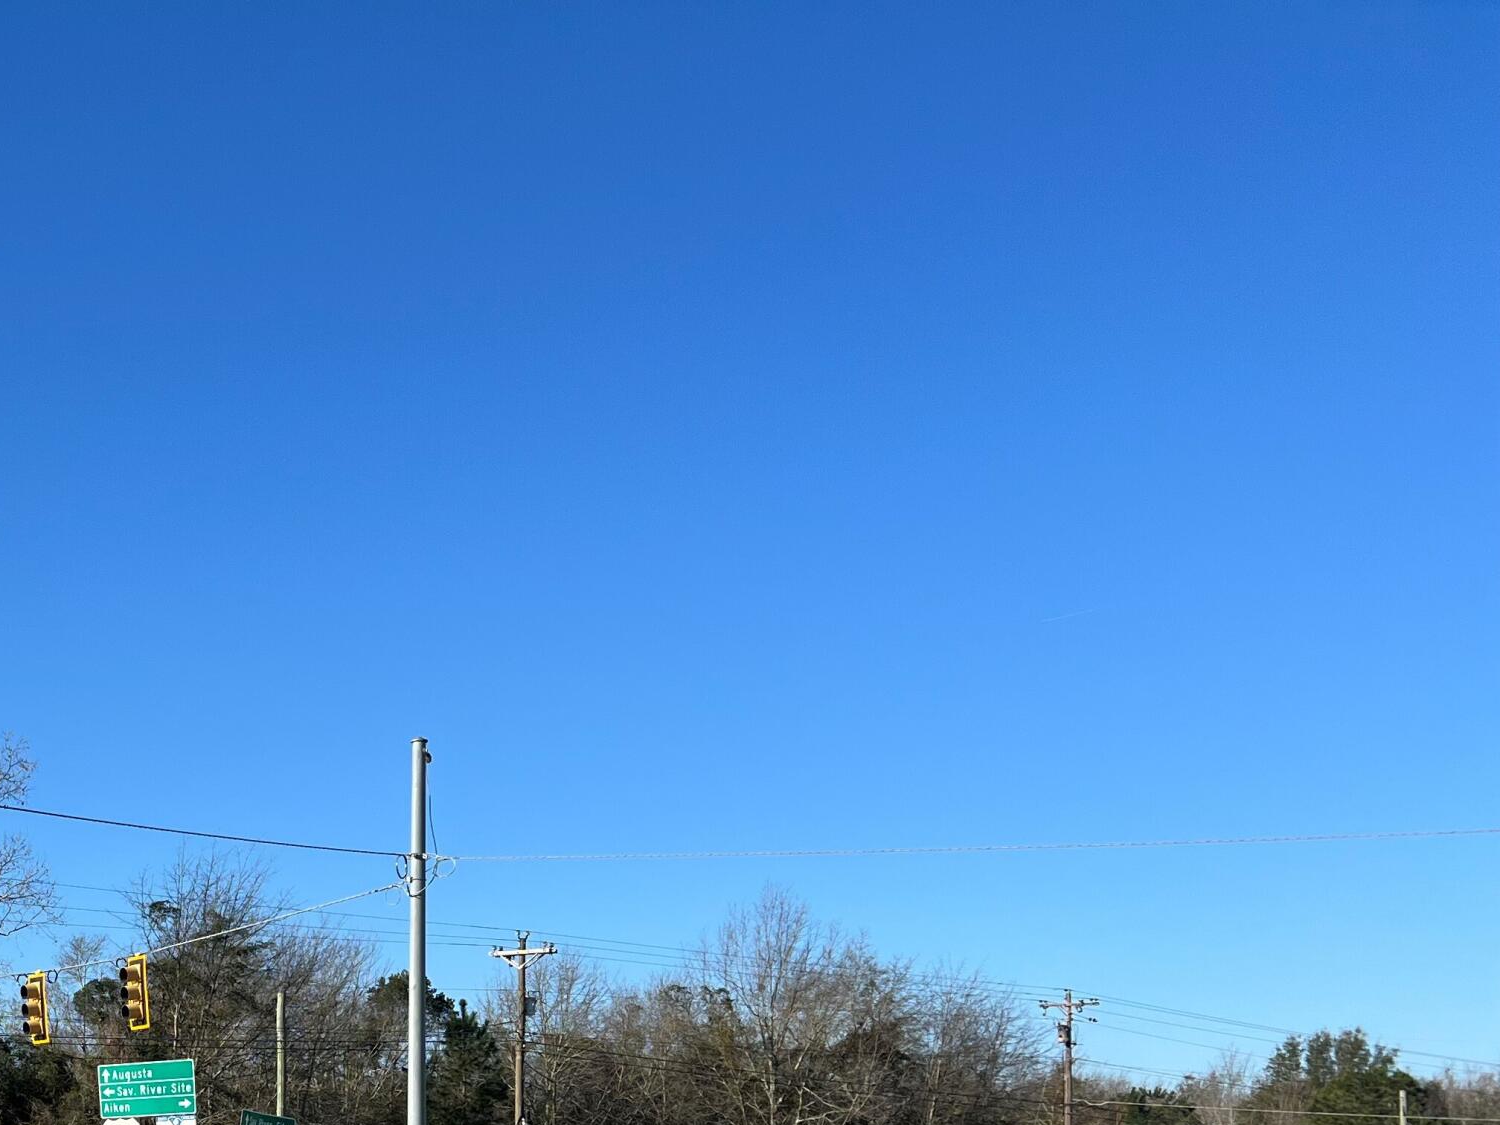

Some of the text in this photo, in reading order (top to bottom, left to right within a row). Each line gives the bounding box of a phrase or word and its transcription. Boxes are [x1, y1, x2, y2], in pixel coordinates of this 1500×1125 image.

[112, 1068, 153, 1083] Augusta
[116, 1082, 192, 1097] Sav. River Site
[103, 1103, 131, 1113] Aiken
